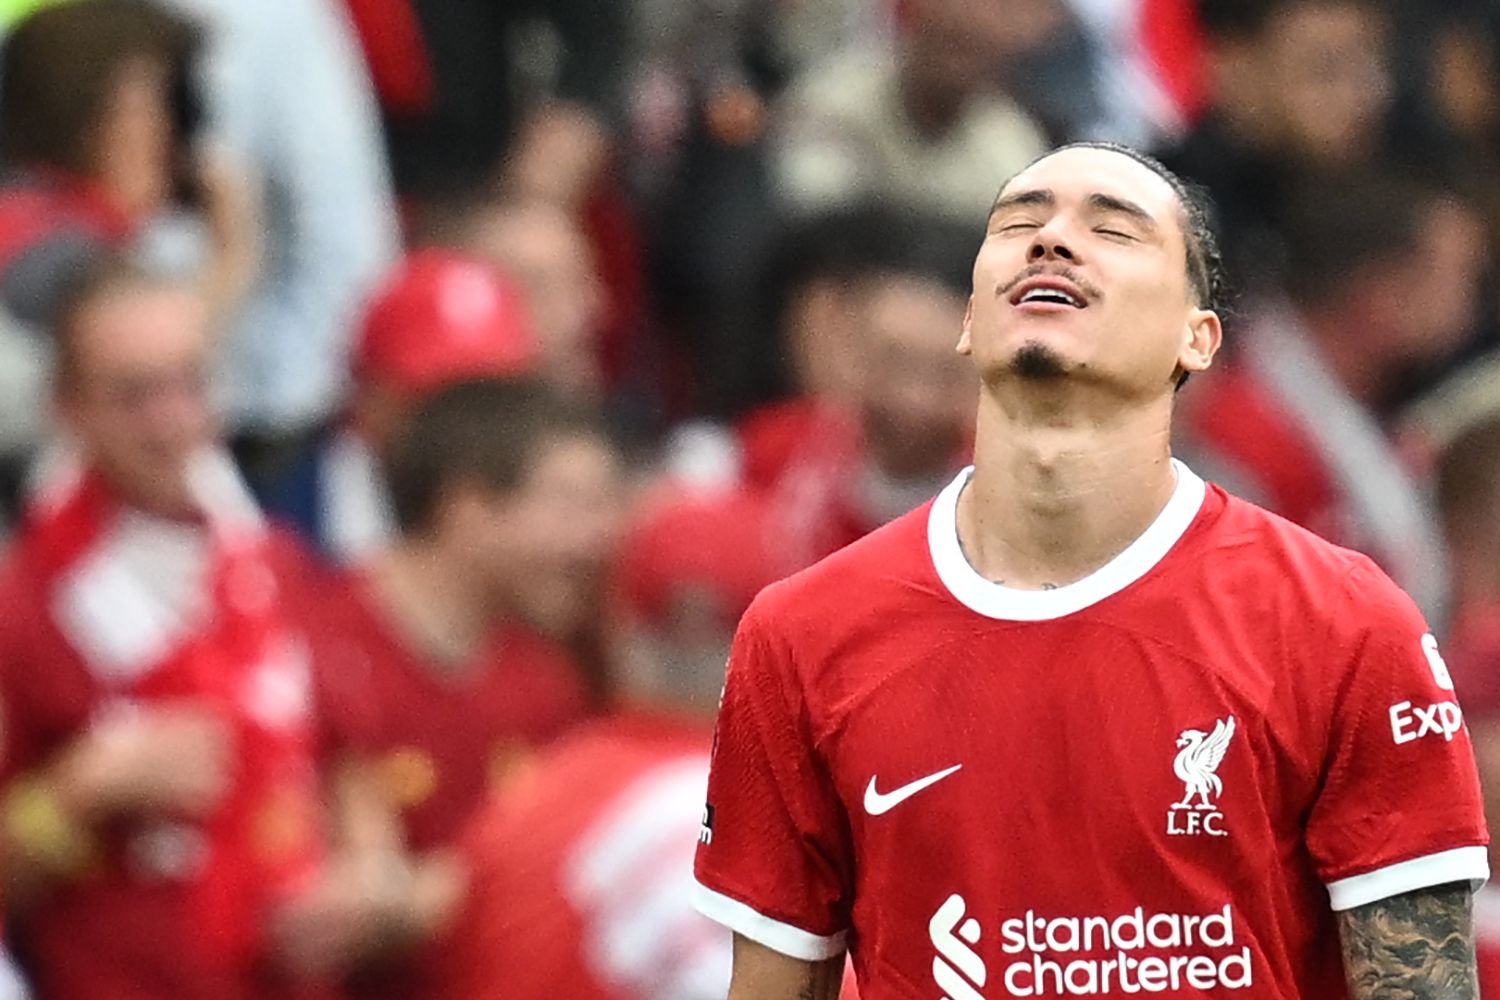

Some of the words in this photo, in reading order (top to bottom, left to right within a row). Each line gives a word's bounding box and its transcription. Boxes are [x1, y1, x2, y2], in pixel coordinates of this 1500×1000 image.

[1389, 700, 1469, 745] Exp
[1166, 811, 1228, 836] L.F.C.
[1001, 903, 1234, 954] standard
[1004, 946, 1253, 997] chartered
